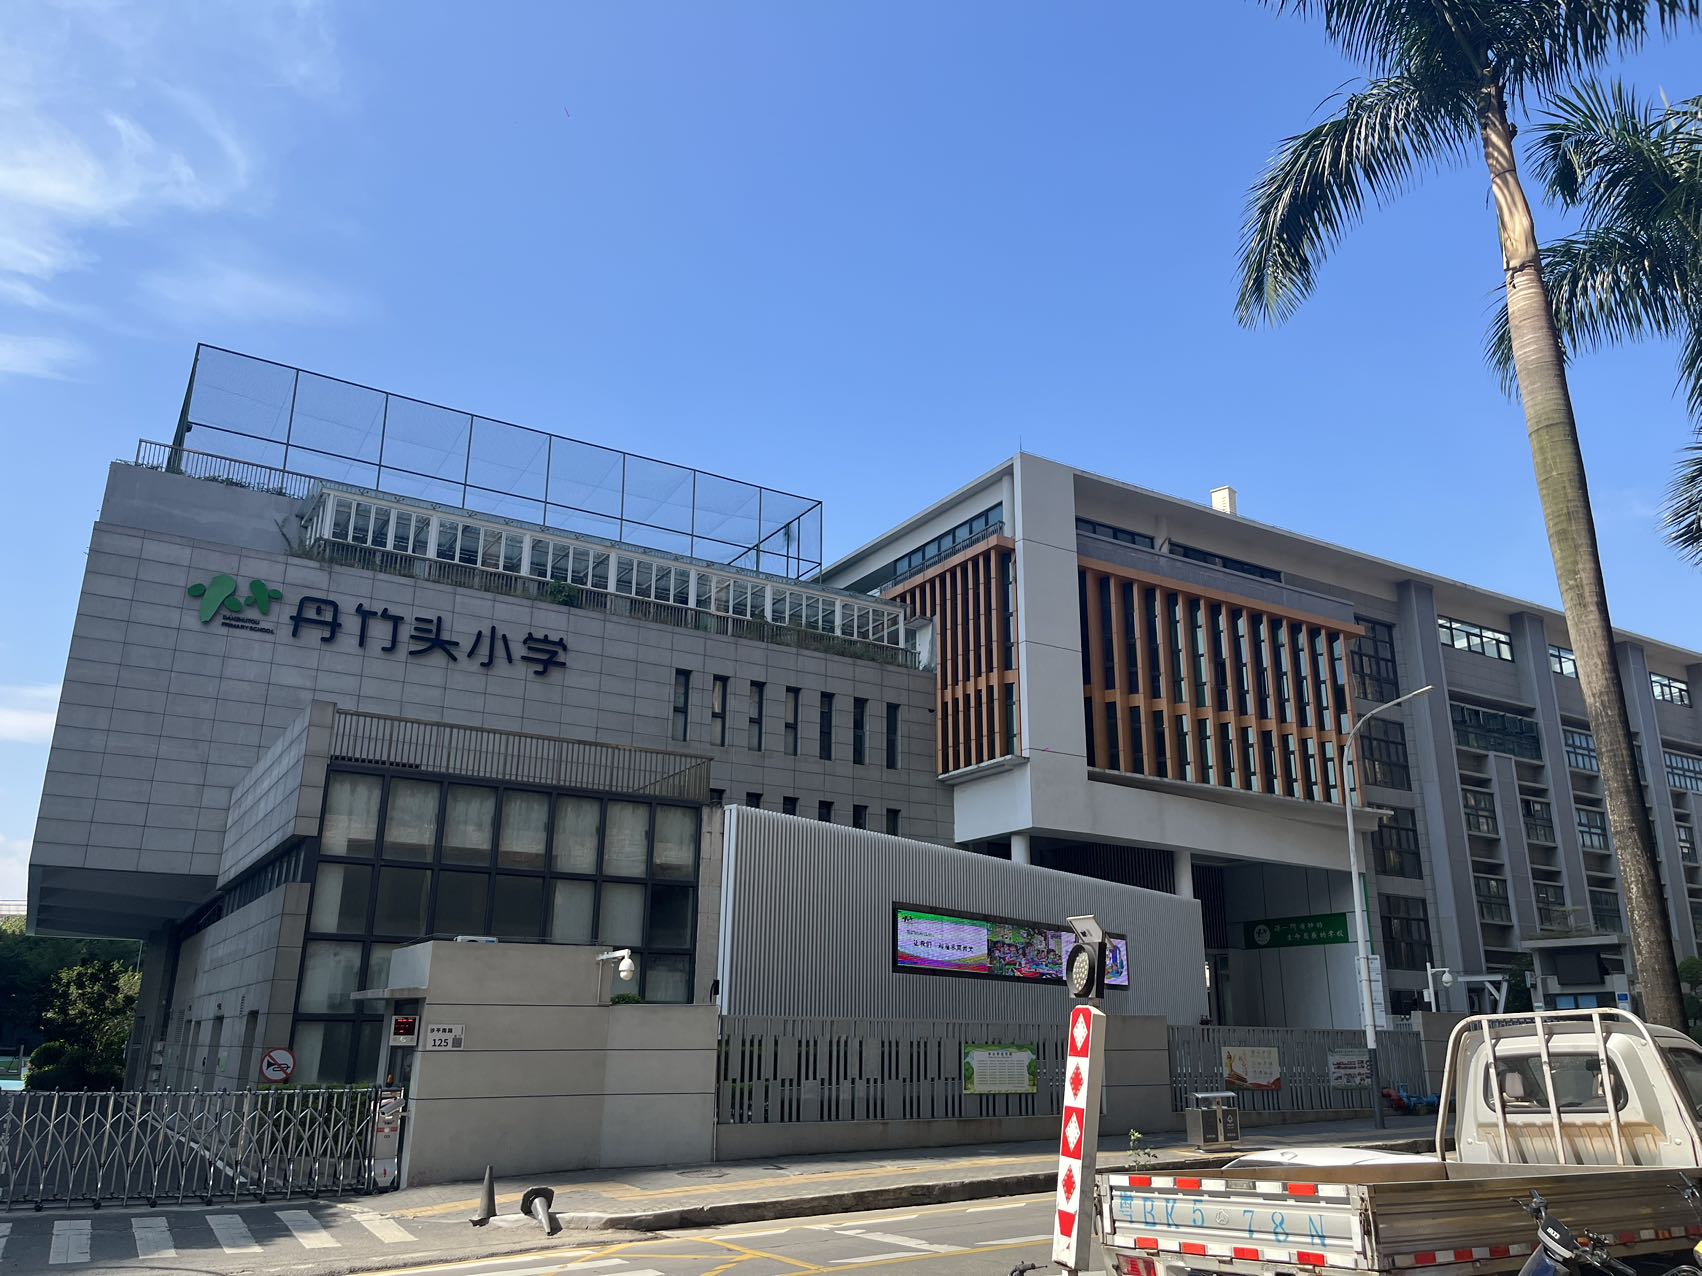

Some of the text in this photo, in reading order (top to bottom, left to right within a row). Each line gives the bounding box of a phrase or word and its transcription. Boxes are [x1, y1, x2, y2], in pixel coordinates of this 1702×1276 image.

[249, 626, 275, 634] SCHOOL
[290, 596, 567, 676] 丹竹头小学
[431, 1038, 449, 1047] 125
